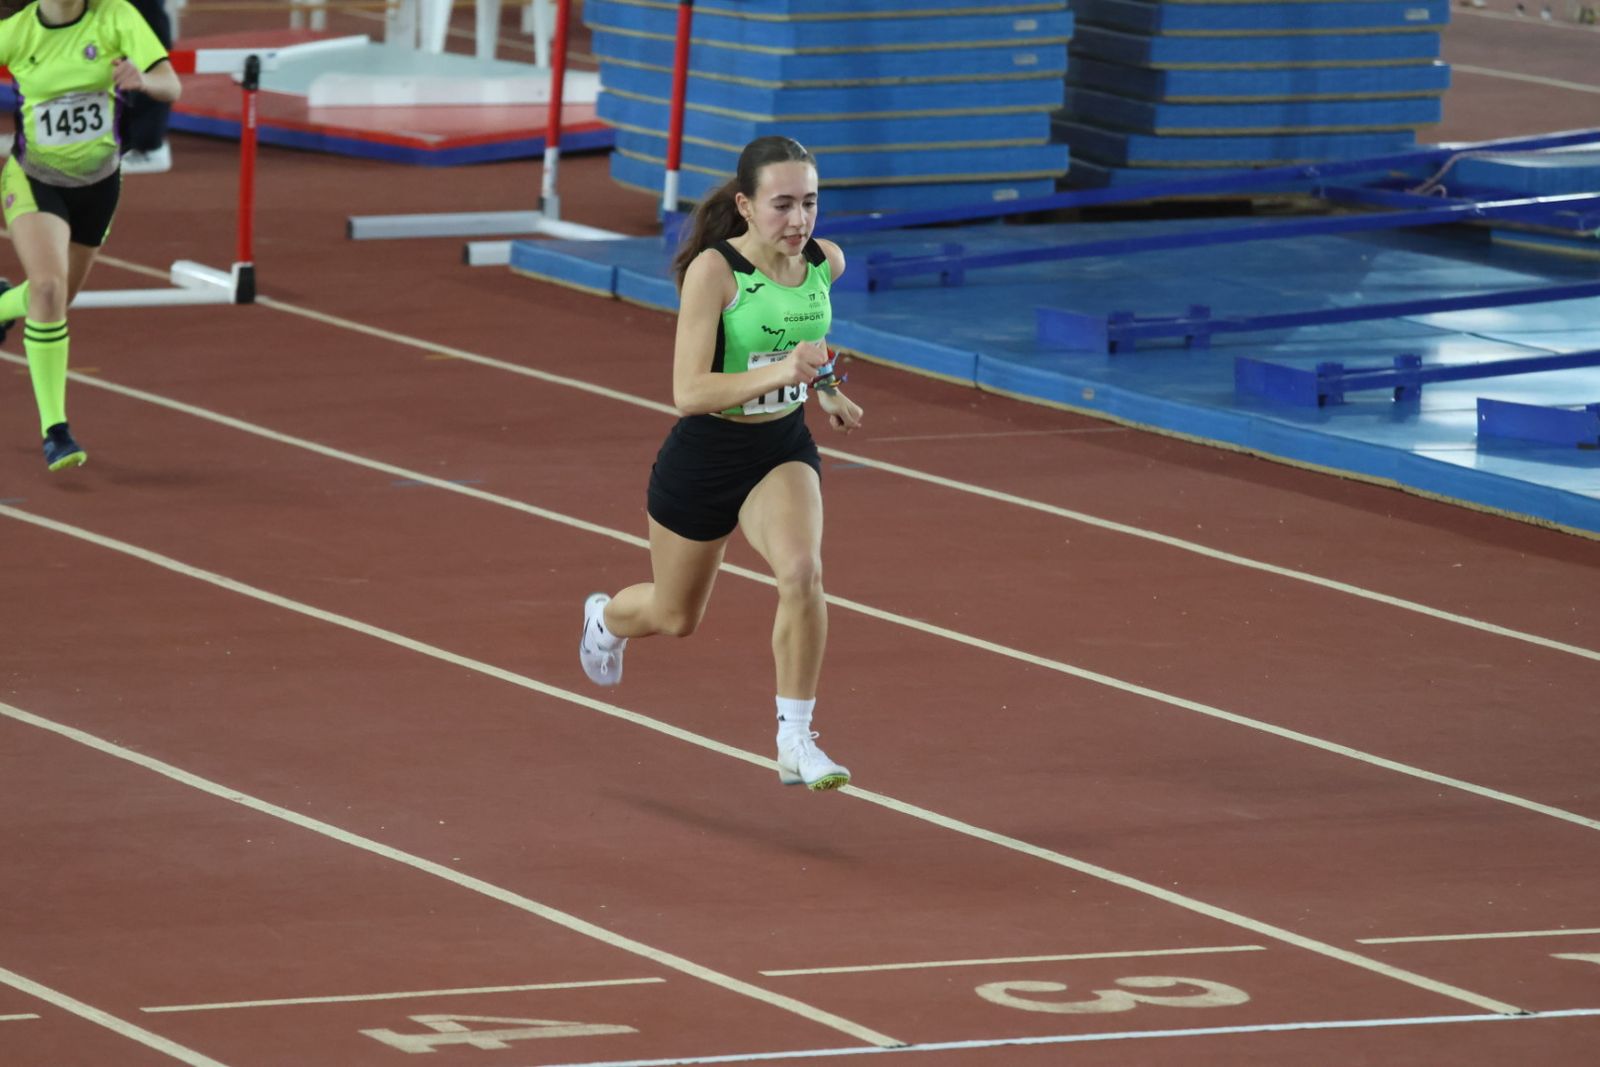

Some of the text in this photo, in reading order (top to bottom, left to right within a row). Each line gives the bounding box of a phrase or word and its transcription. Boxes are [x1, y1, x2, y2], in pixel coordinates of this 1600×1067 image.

[41, 103, 103, 137] 1453
[975, 976, 1250, 1013] 3
[357, 1014, 640, 1054] 4
